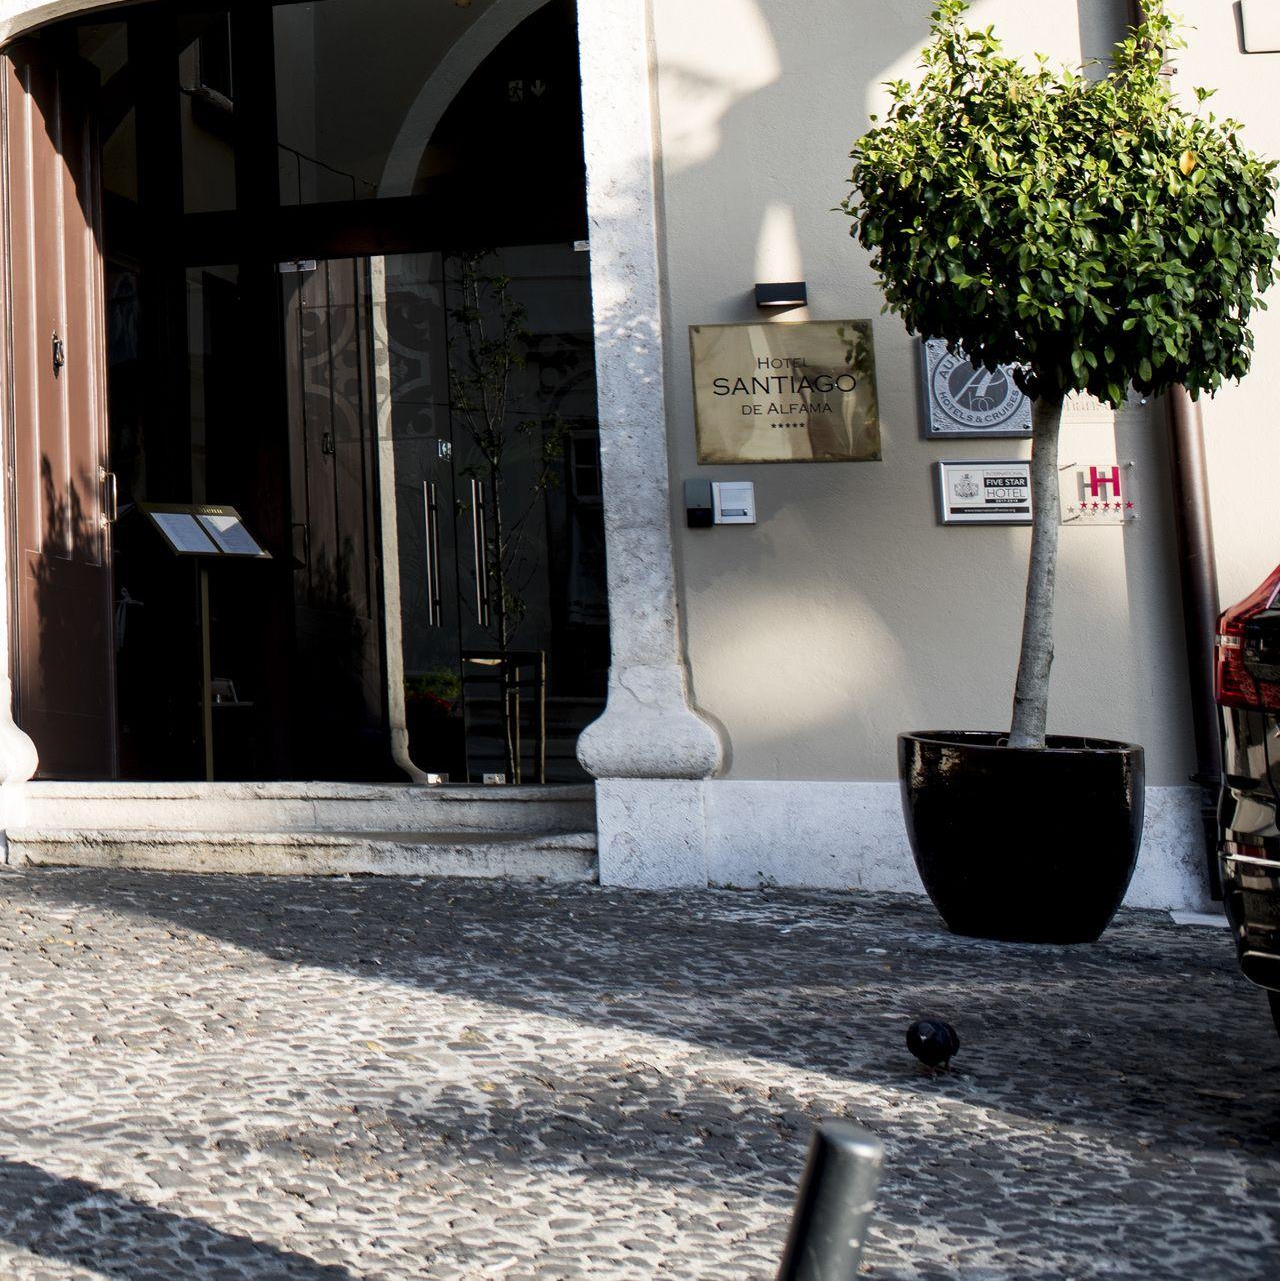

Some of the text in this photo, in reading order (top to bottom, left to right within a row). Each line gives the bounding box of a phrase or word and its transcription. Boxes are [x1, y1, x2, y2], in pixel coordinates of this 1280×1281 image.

[757, 357, 810, 369] HOTEL
[712, 373, 857, 396] SANTIAGO
[741, 402, 833, 416] DE ALFAMA
[939, 391, 974, 422] HOTELS
[985, 389, 1020, 423] CRUISES
[987, 488, 1026, 498] HOTEL
